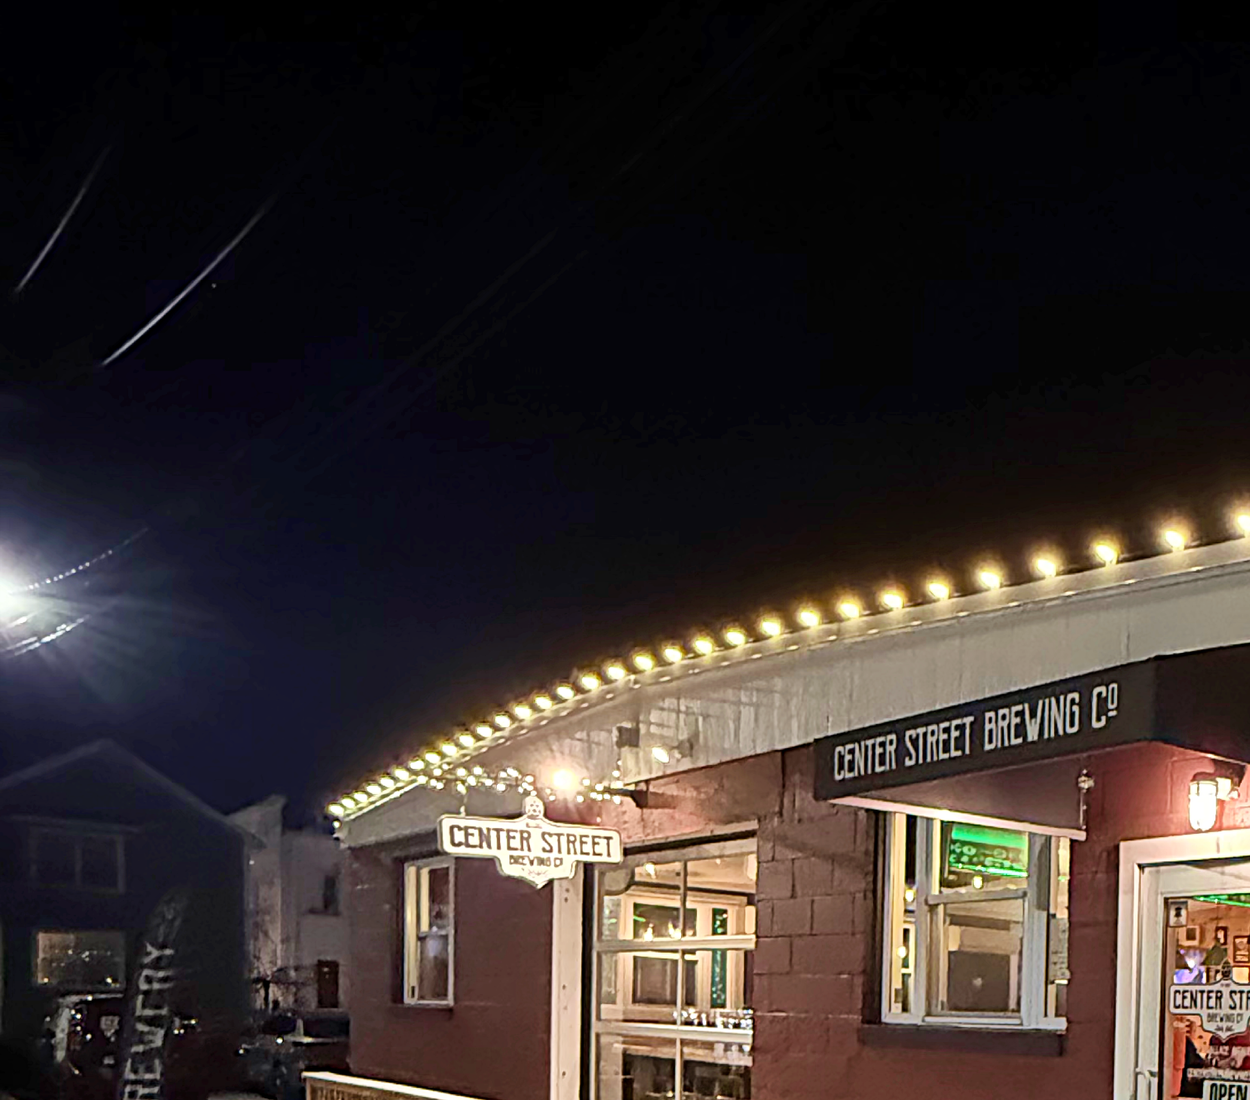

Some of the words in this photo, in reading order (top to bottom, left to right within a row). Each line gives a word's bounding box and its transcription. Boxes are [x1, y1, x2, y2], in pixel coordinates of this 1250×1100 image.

[834, 734, 897, 781] CENTER
[904, 715, 975, 767] STREET
[983, 691, 1080, 751] BREWING
[449, 825, 532, 853] CENTER
[541, 831, 614, 859] STREET
[509, 854, 551, 867] BREWING
[1173, 989, 1223, 1010] CENTER
[1207, 1012, 1235, 1023] BREWING
